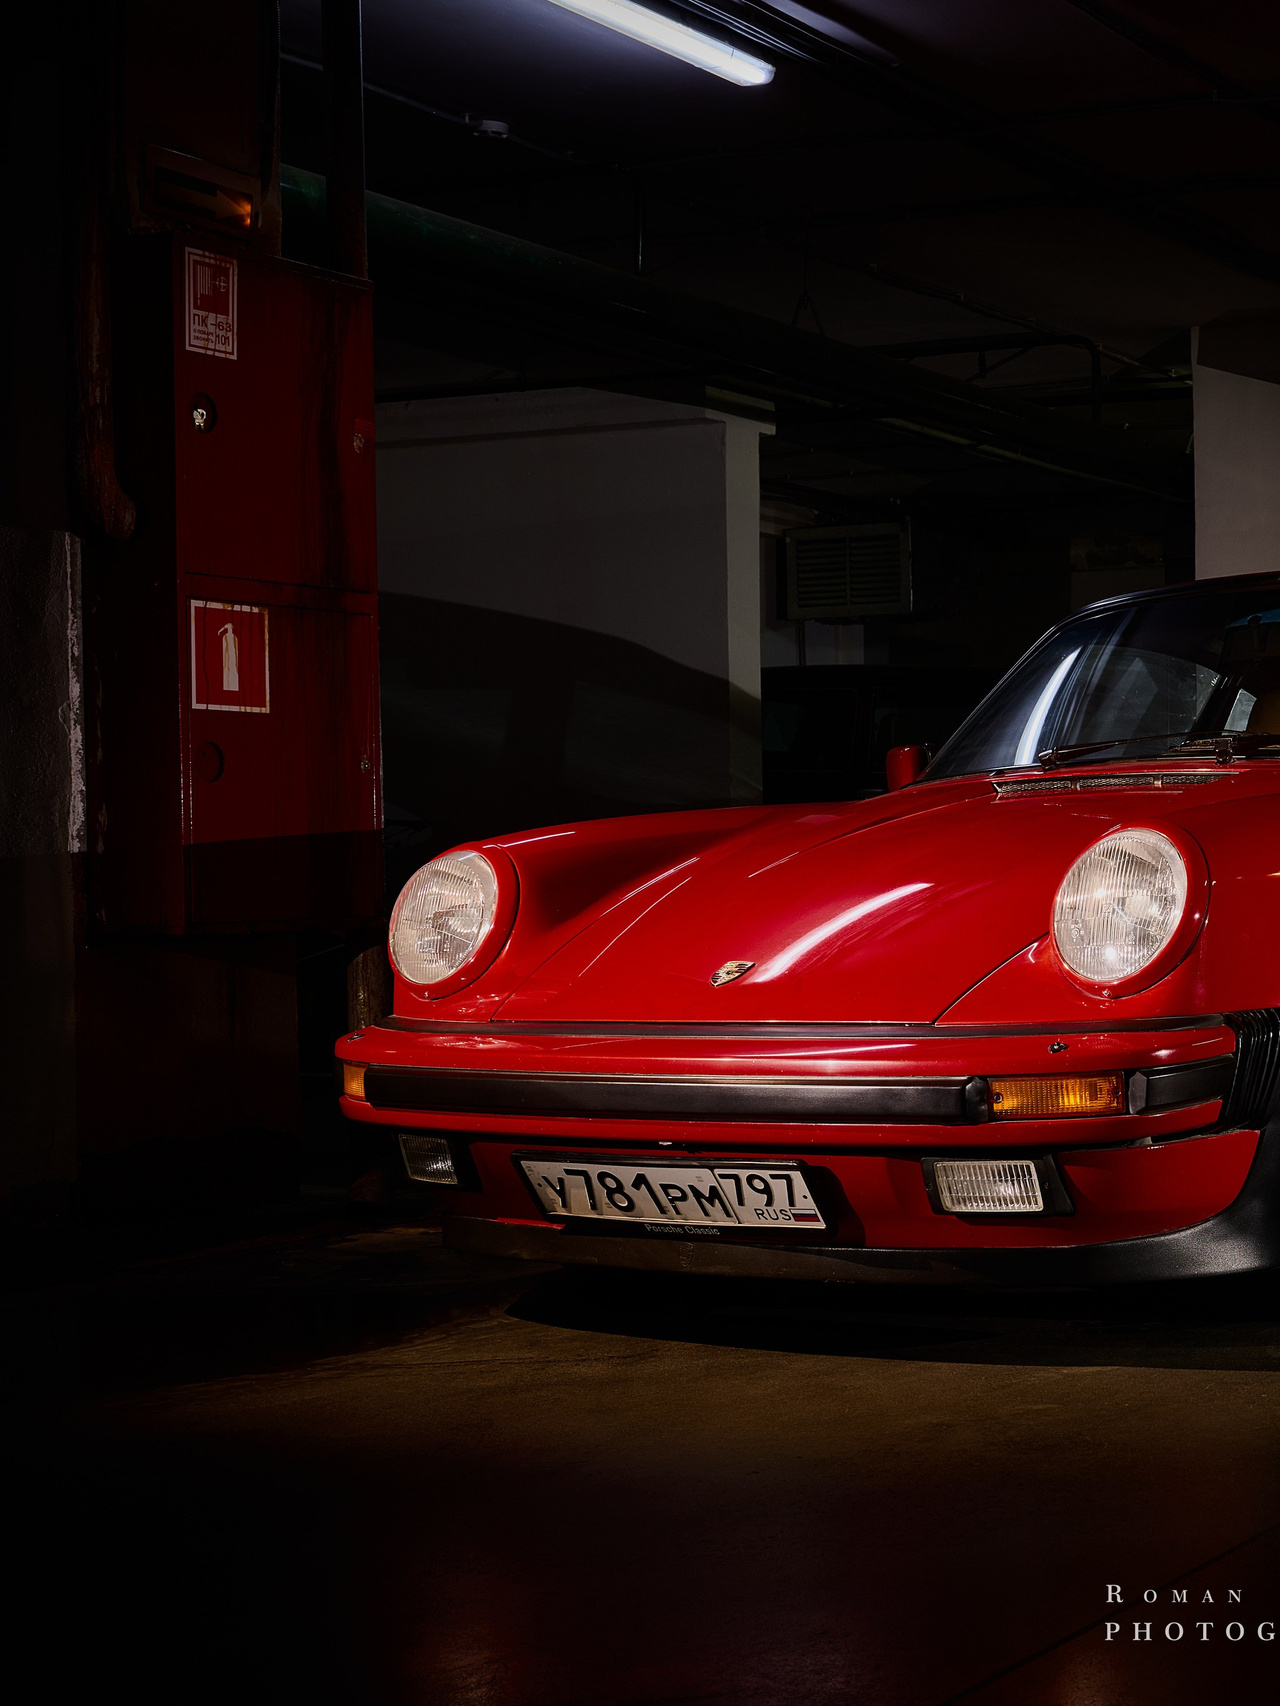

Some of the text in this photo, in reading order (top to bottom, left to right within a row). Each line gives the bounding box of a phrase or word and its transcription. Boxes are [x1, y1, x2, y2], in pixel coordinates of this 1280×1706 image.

[193, 313, 208, 327] ПК
[216, 333, 230, 347] 101
[717, 1173, 797, 1208] 797
[754, 1208, 792, 1222] RUS
[644, 1223, 721, 1236] Porsche Classic
